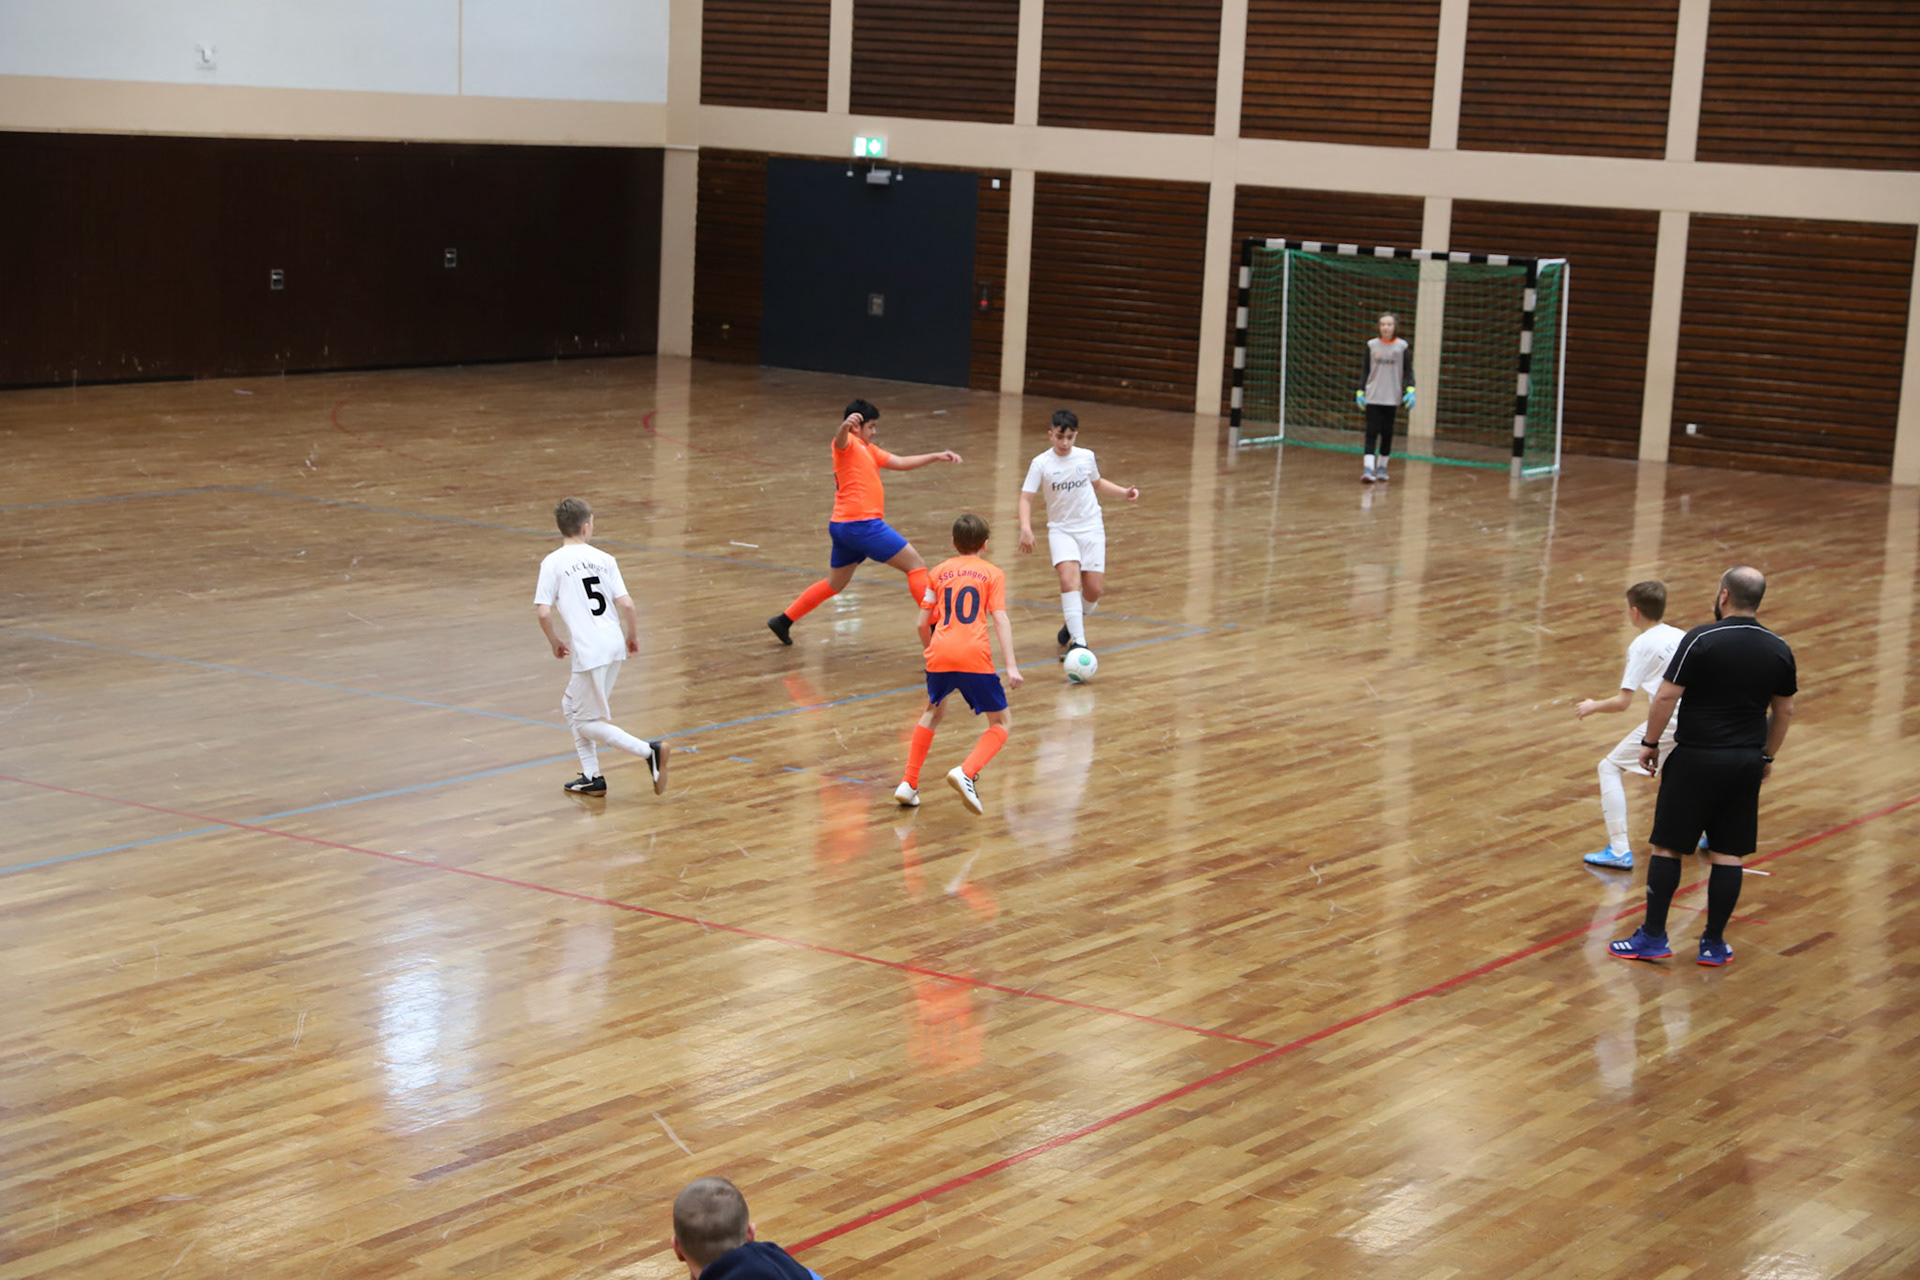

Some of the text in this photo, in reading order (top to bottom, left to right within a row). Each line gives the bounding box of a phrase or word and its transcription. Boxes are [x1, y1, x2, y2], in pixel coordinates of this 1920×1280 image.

[582, 576, 606, 616] 5
[938, 570, 988, 583] SSG Langen
[943, 586, 980, 626] 10
